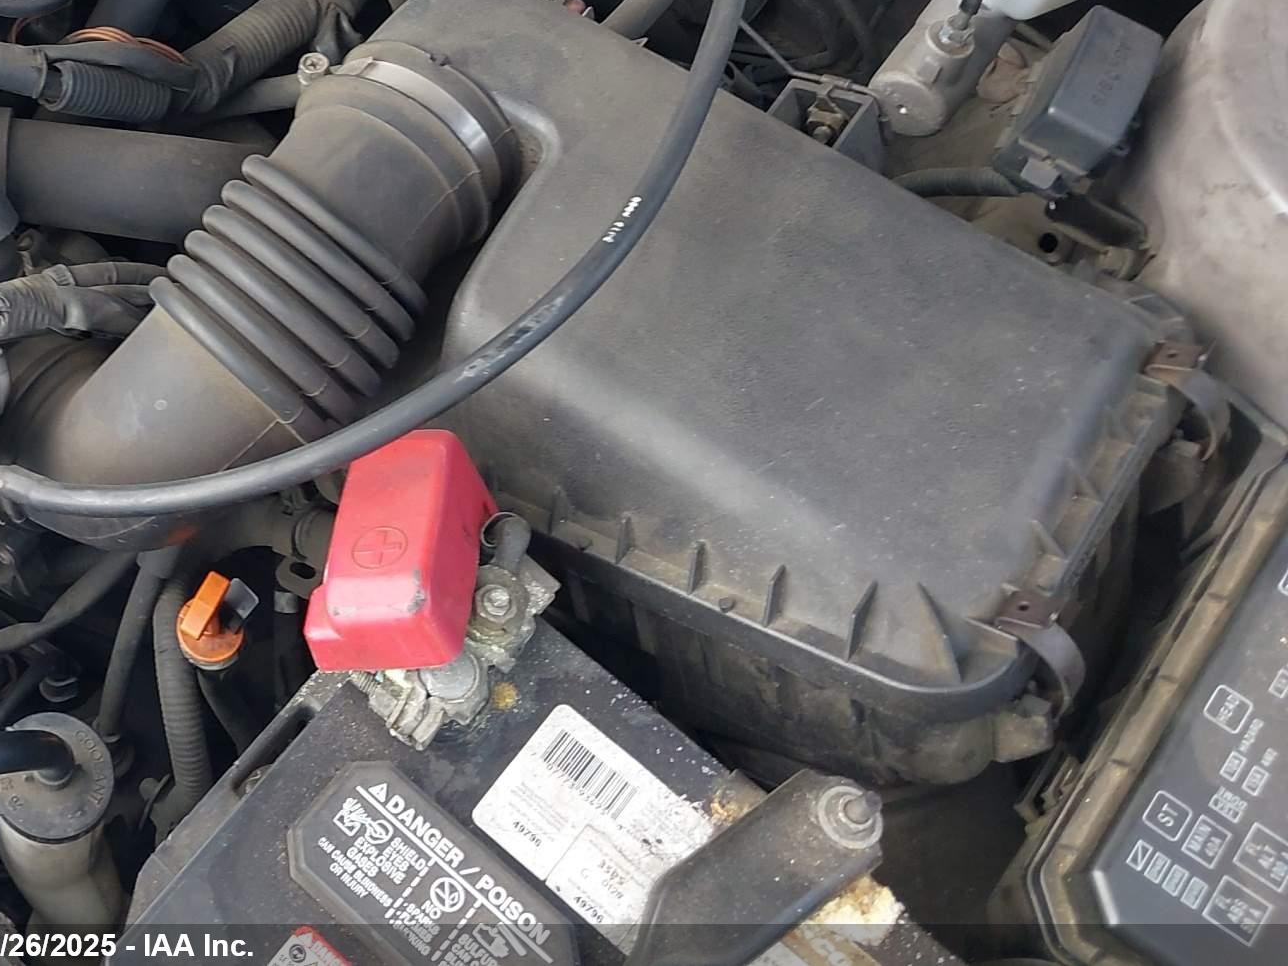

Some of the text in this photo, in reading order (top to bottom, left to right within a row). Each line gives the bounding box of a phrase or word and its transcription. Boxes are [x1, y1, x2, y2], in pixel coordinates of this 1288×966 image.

[74, 729, 105, 803] COOLANT
[1155, 802, 1180, 828] ST
[511, 819, 541, 847] 49796
[1187, 822, 1212, 853] MAIN
[344, 846, 378, 878] GASES
[352, 836, 405, 885] EXPLOSIVE
[381, 845, 410, 872] EYES
[389, 836, 426, 871] SHIELD
[316, 836, 392, 907] CAN CAUSE BLINDNESS
[328, 862, 368, 899] OR INJURY
[384, 794, 466, 869] DANGER
[474, 873, 552, 946] POISON
[419, 900, 441, 920] NO
[571, 893, 605, 924] 49796
